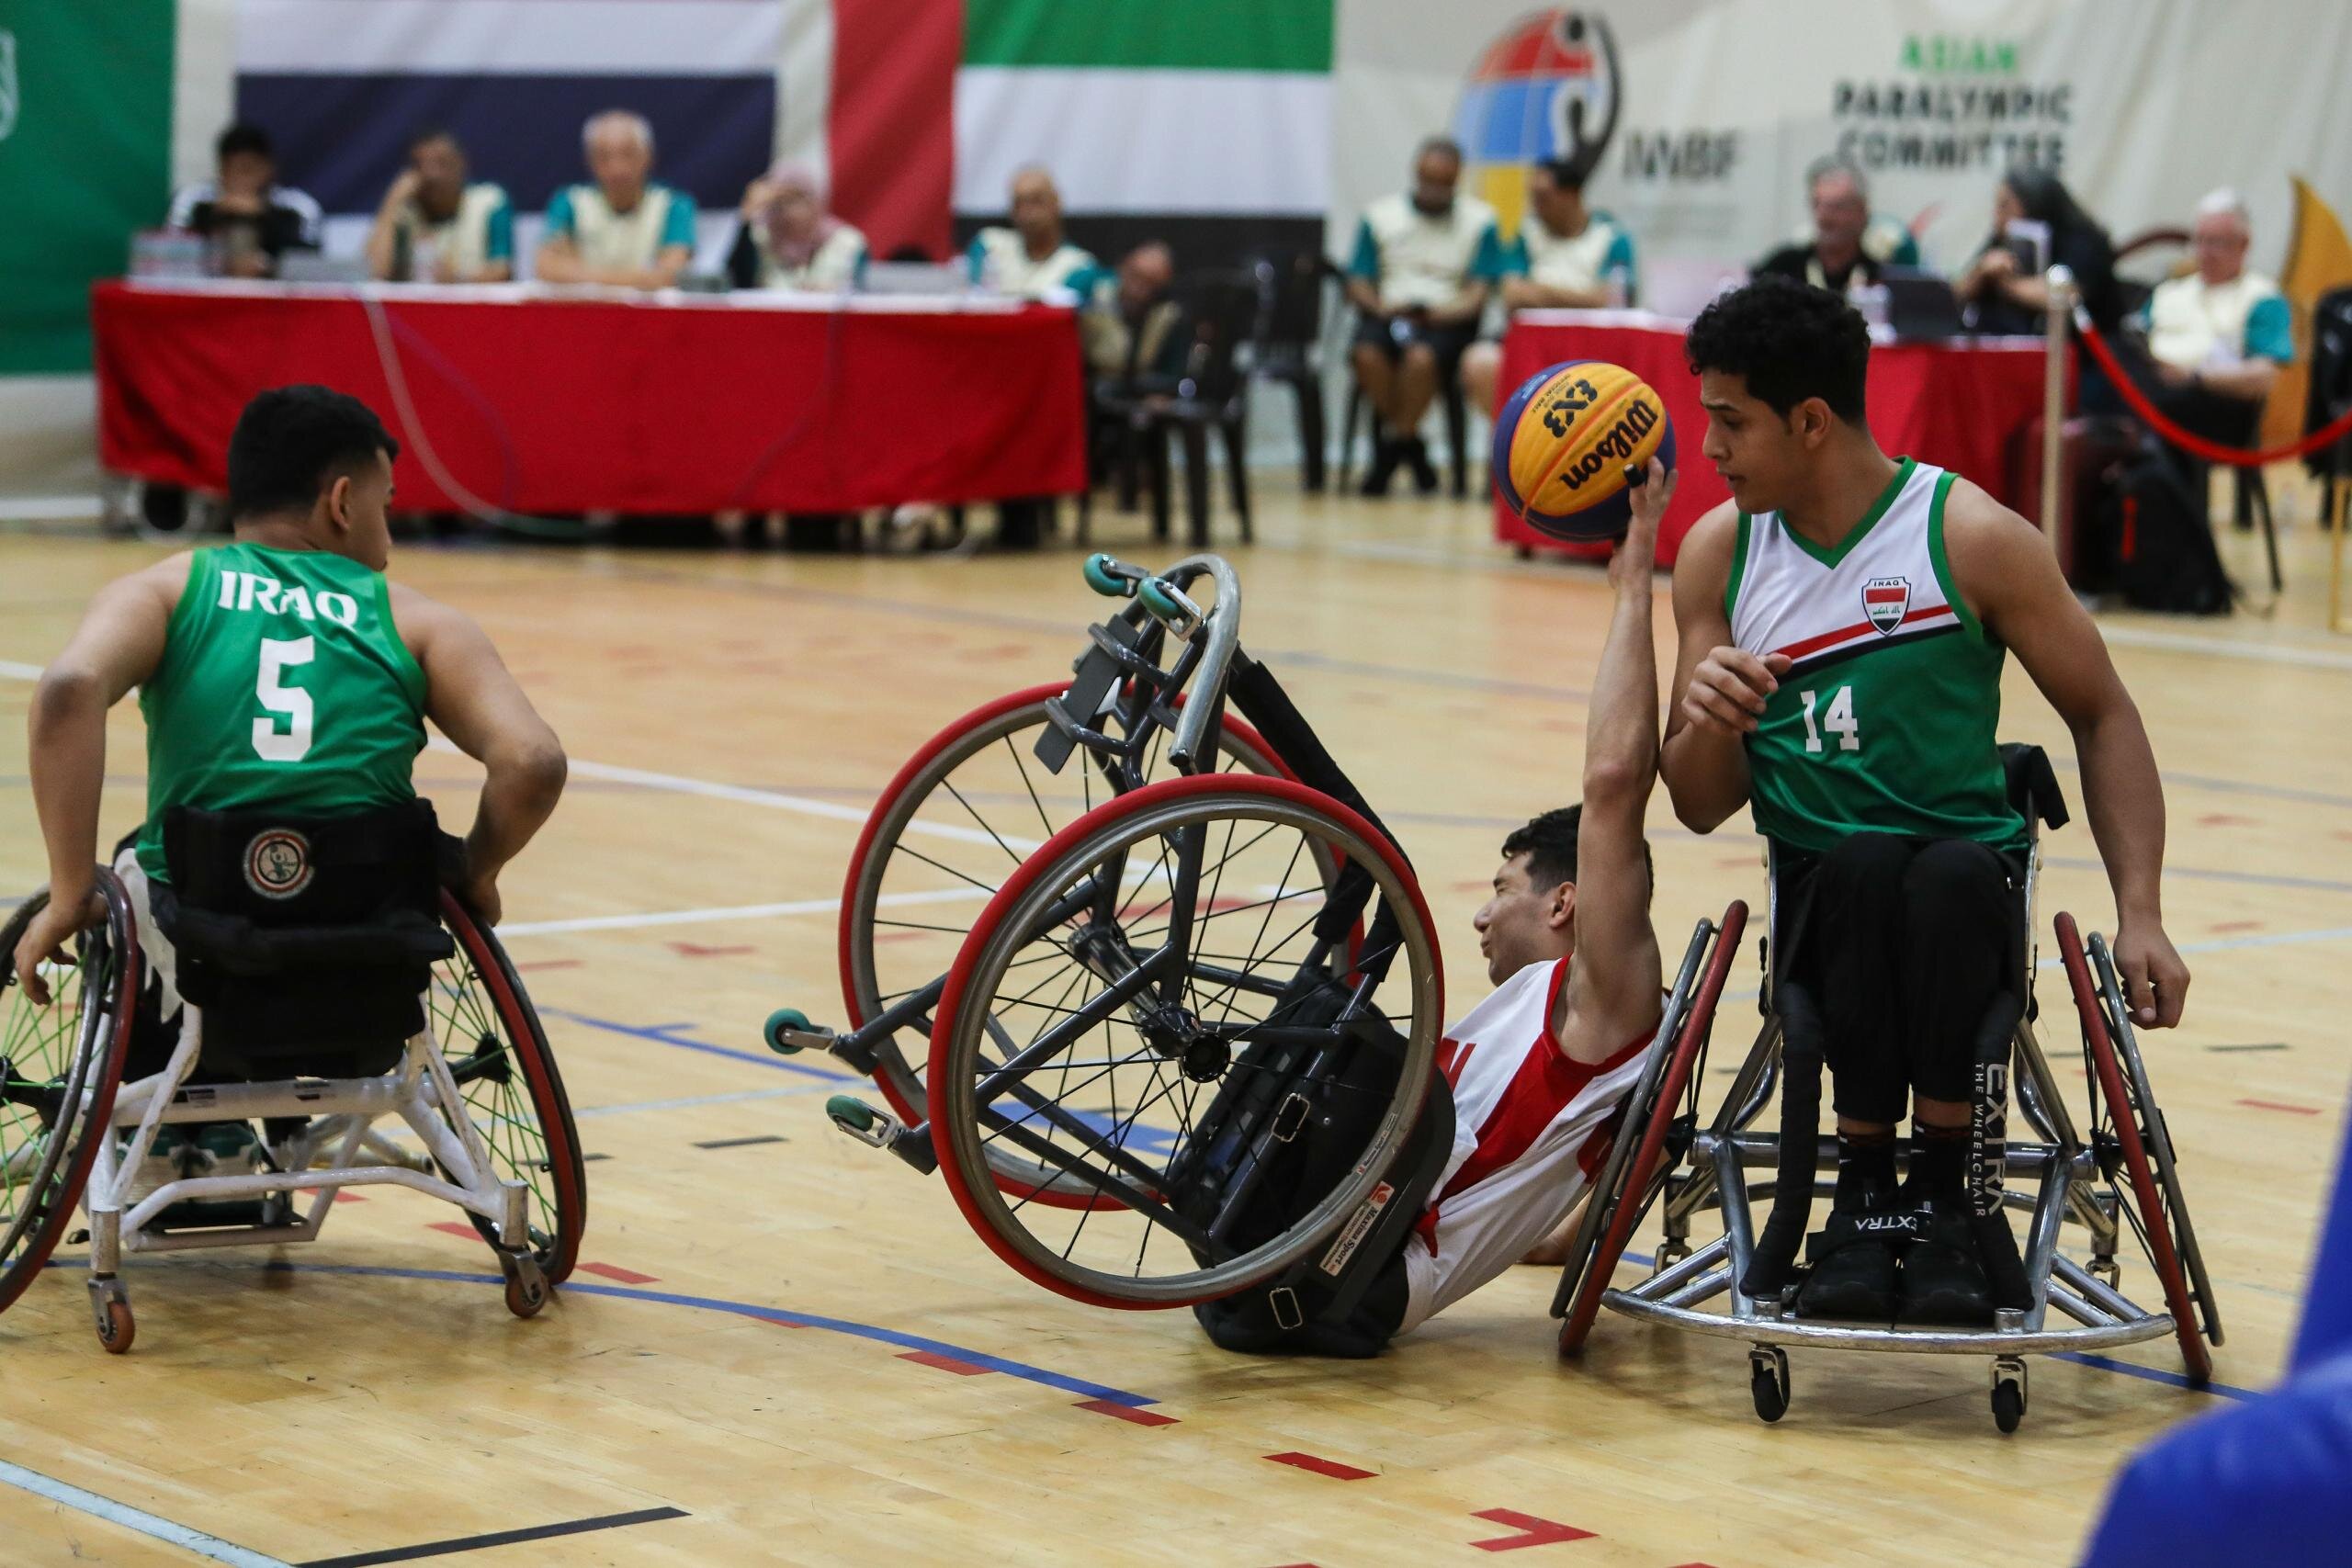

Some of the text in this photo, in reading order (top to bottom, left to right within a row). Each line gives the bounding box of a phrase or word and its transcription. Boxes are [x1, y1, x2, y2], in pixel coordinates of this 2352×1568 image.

[1900, 37, 2018, 73] ASIAN
[1834, 83, 2072, 123] PARALYMPIC
[1838, 131, 2064, 170] COMMITTEE
[1559, 399, 1658, 491] Wilson
[217, 570, 358, 634] IRAQ
[252, 635, 315, 762] 5
[1800, 685, 1860, 752] 14
[1972, 1062, 1985, 1216] THE WHEELCHAIR
[1984, 1064, 2008, 1216] EXTRA
[1335, 1239, 1355, 1265] Sport
